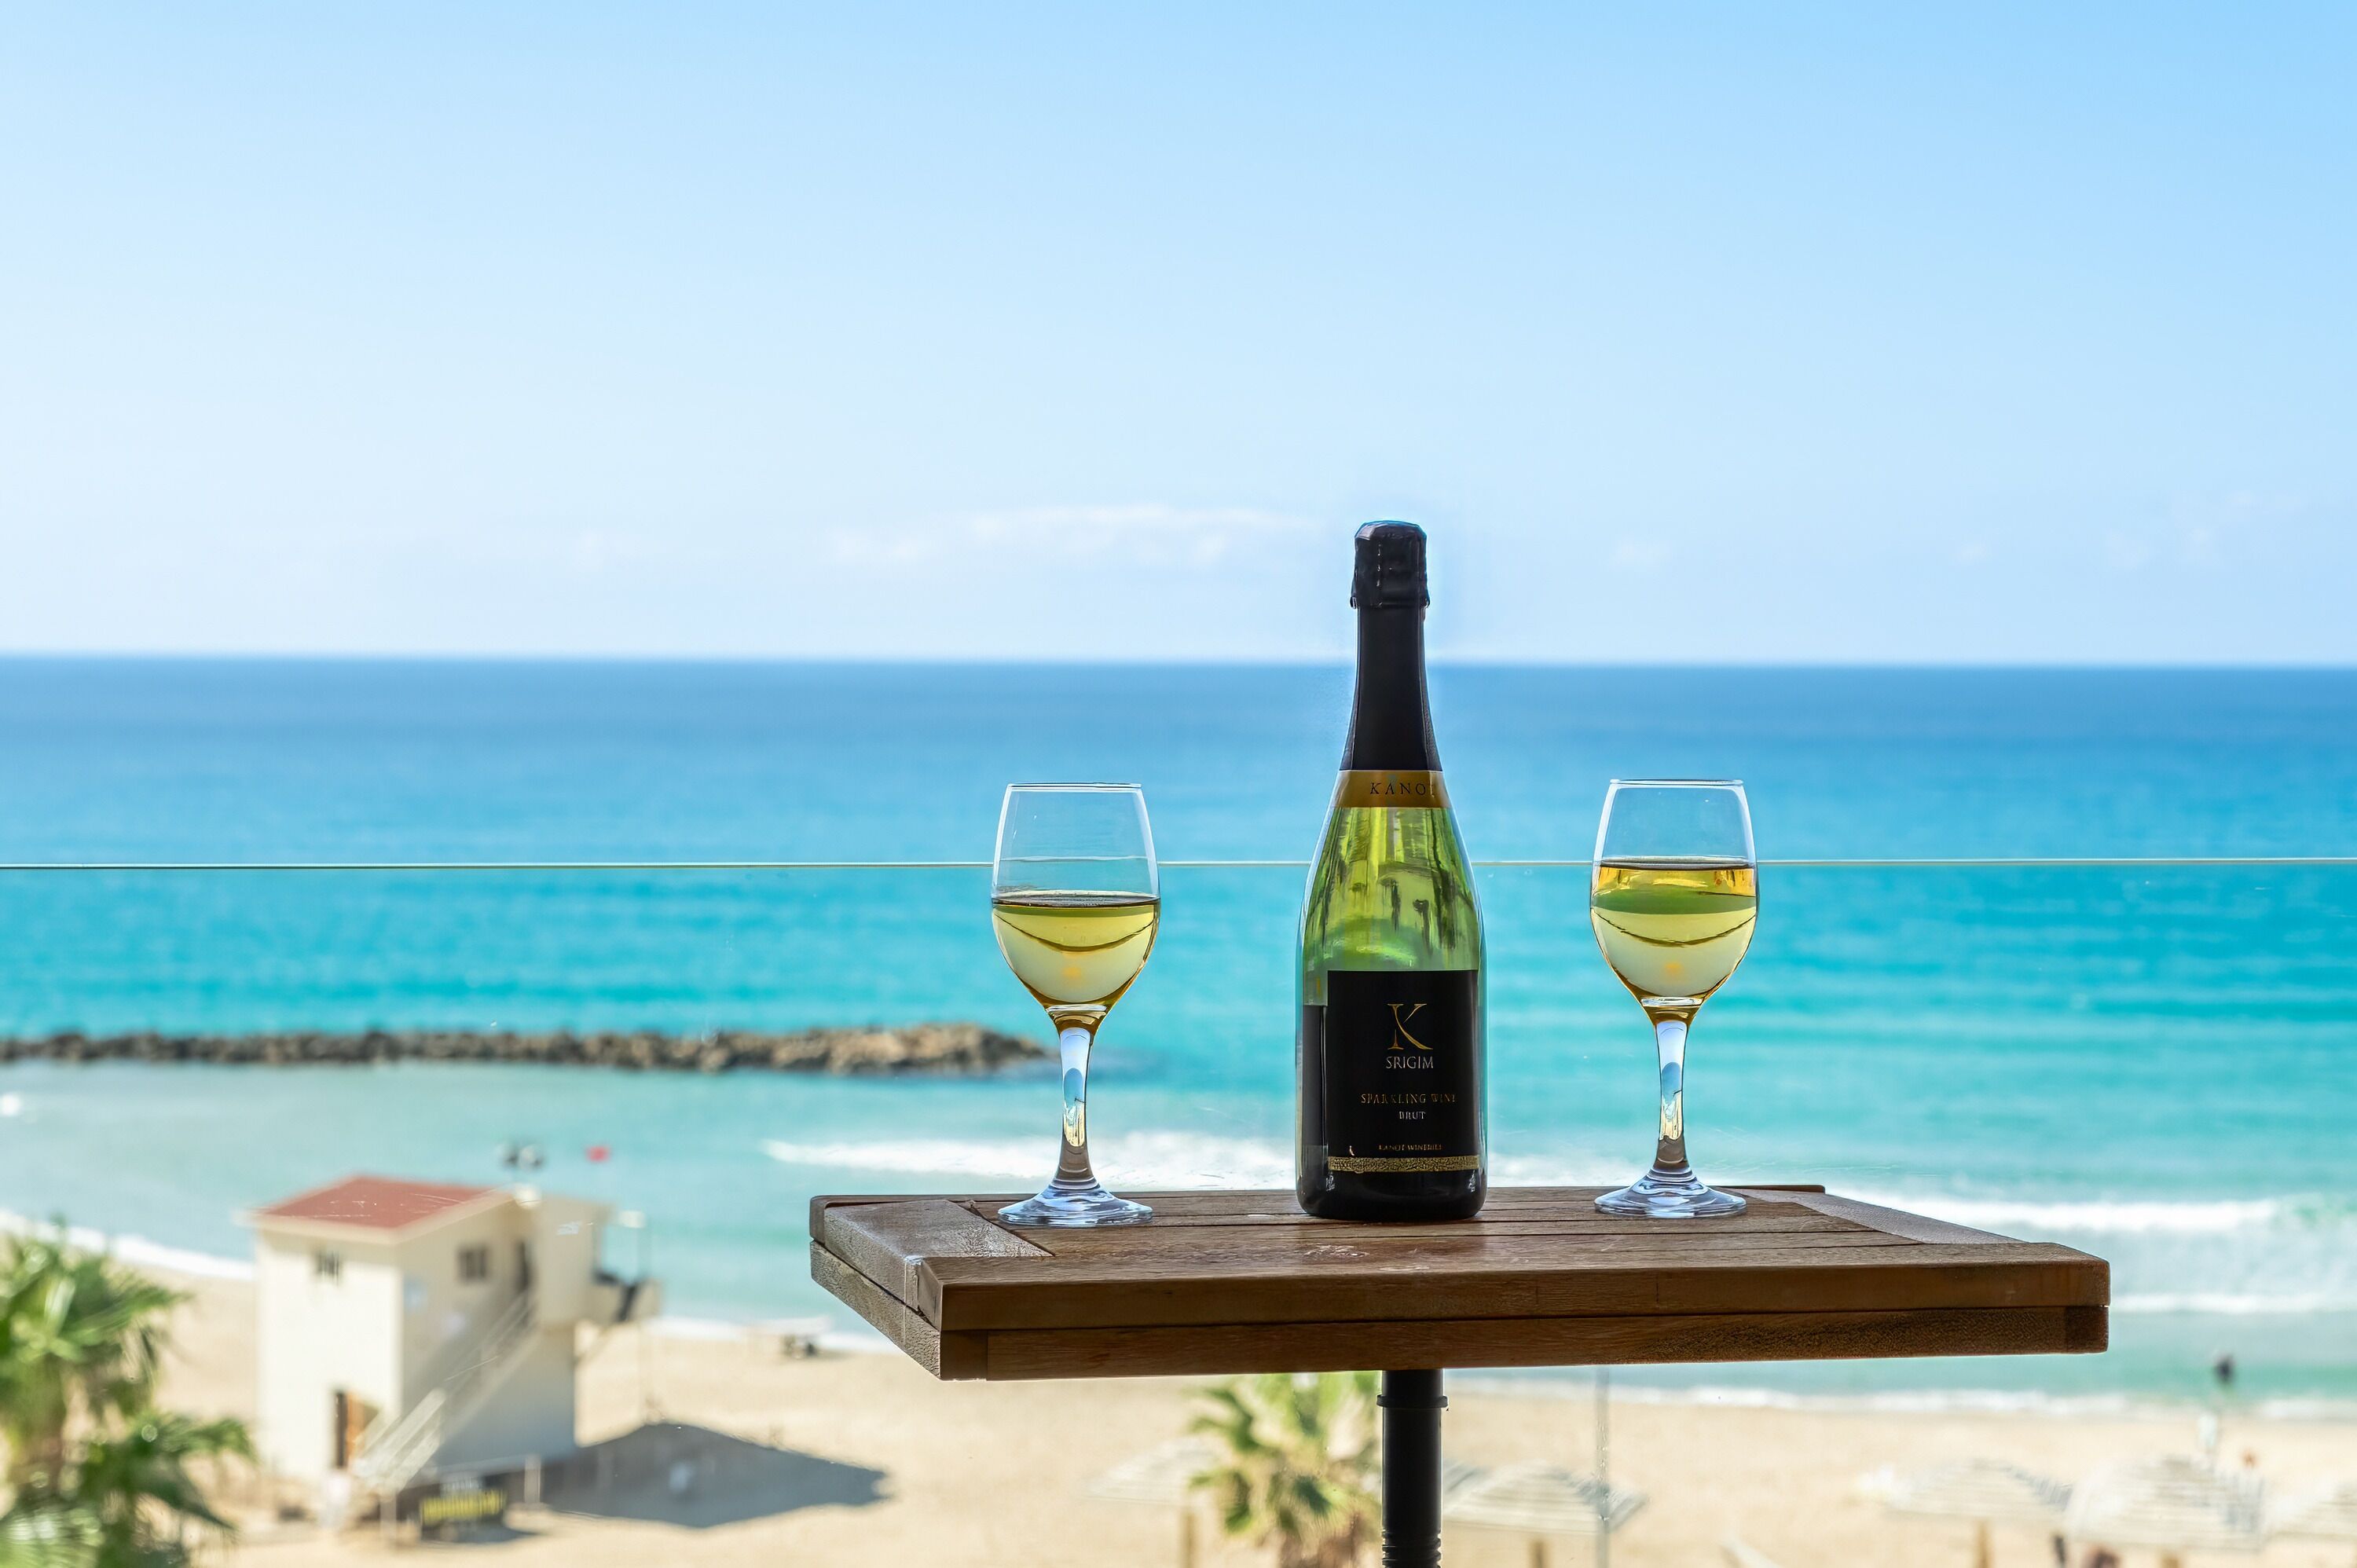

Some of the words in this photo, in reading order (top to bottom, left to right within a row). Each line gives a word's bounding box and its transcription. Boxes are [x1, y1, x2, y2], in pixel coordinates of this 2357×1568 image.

[1385, 1056, 1434, 1069] SRIGIM
[1361, 1093, 1426, 1104] SPARKLING
[1398, 1111, 1426, 1119] BRUT
